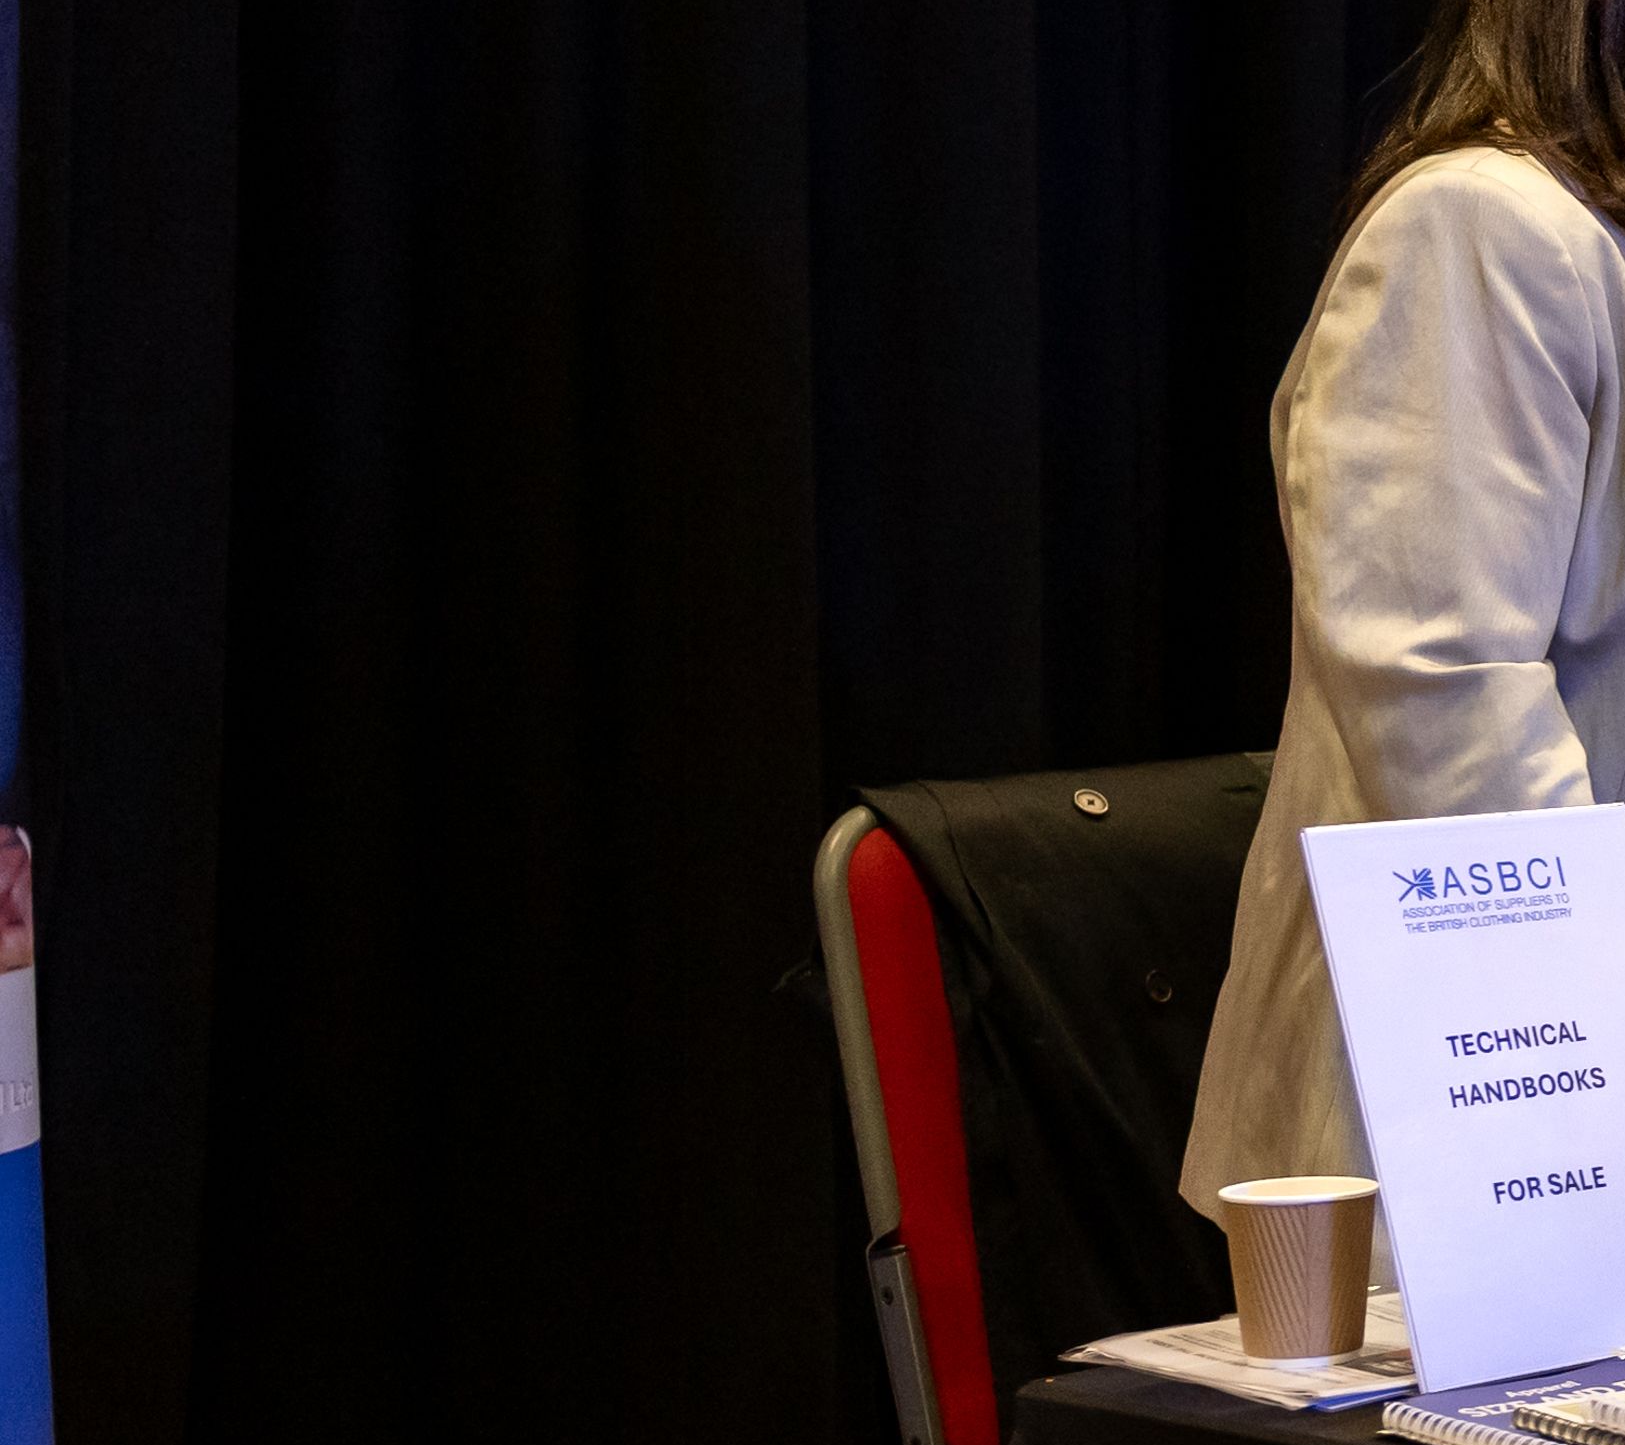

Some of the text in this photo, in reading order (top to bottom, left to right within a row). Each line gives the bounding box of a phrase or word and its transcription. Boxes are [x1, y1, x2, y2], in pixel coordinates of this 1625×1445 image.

[1443, 856, 1566, 898] ASBCI
[1402, 893, 1570, 919] ASSOCIATION OF SUPPLIERS TO
[1405, 908, 1572, 934] THE BRITISH CLOTHING INDUSTRY
[1445, 1020, 1587, 1057] TECHNICAL
[1449, 1067, 1606, 1108] HANDBOOKS
[1493, 1166, 1607, 1204] FOR SALE
[1458, 1400, 1528, 1418] SIZE
[1541, 1386, 1616, 1405] AND
[1505, 1380, 1581, 1398] Apparel
